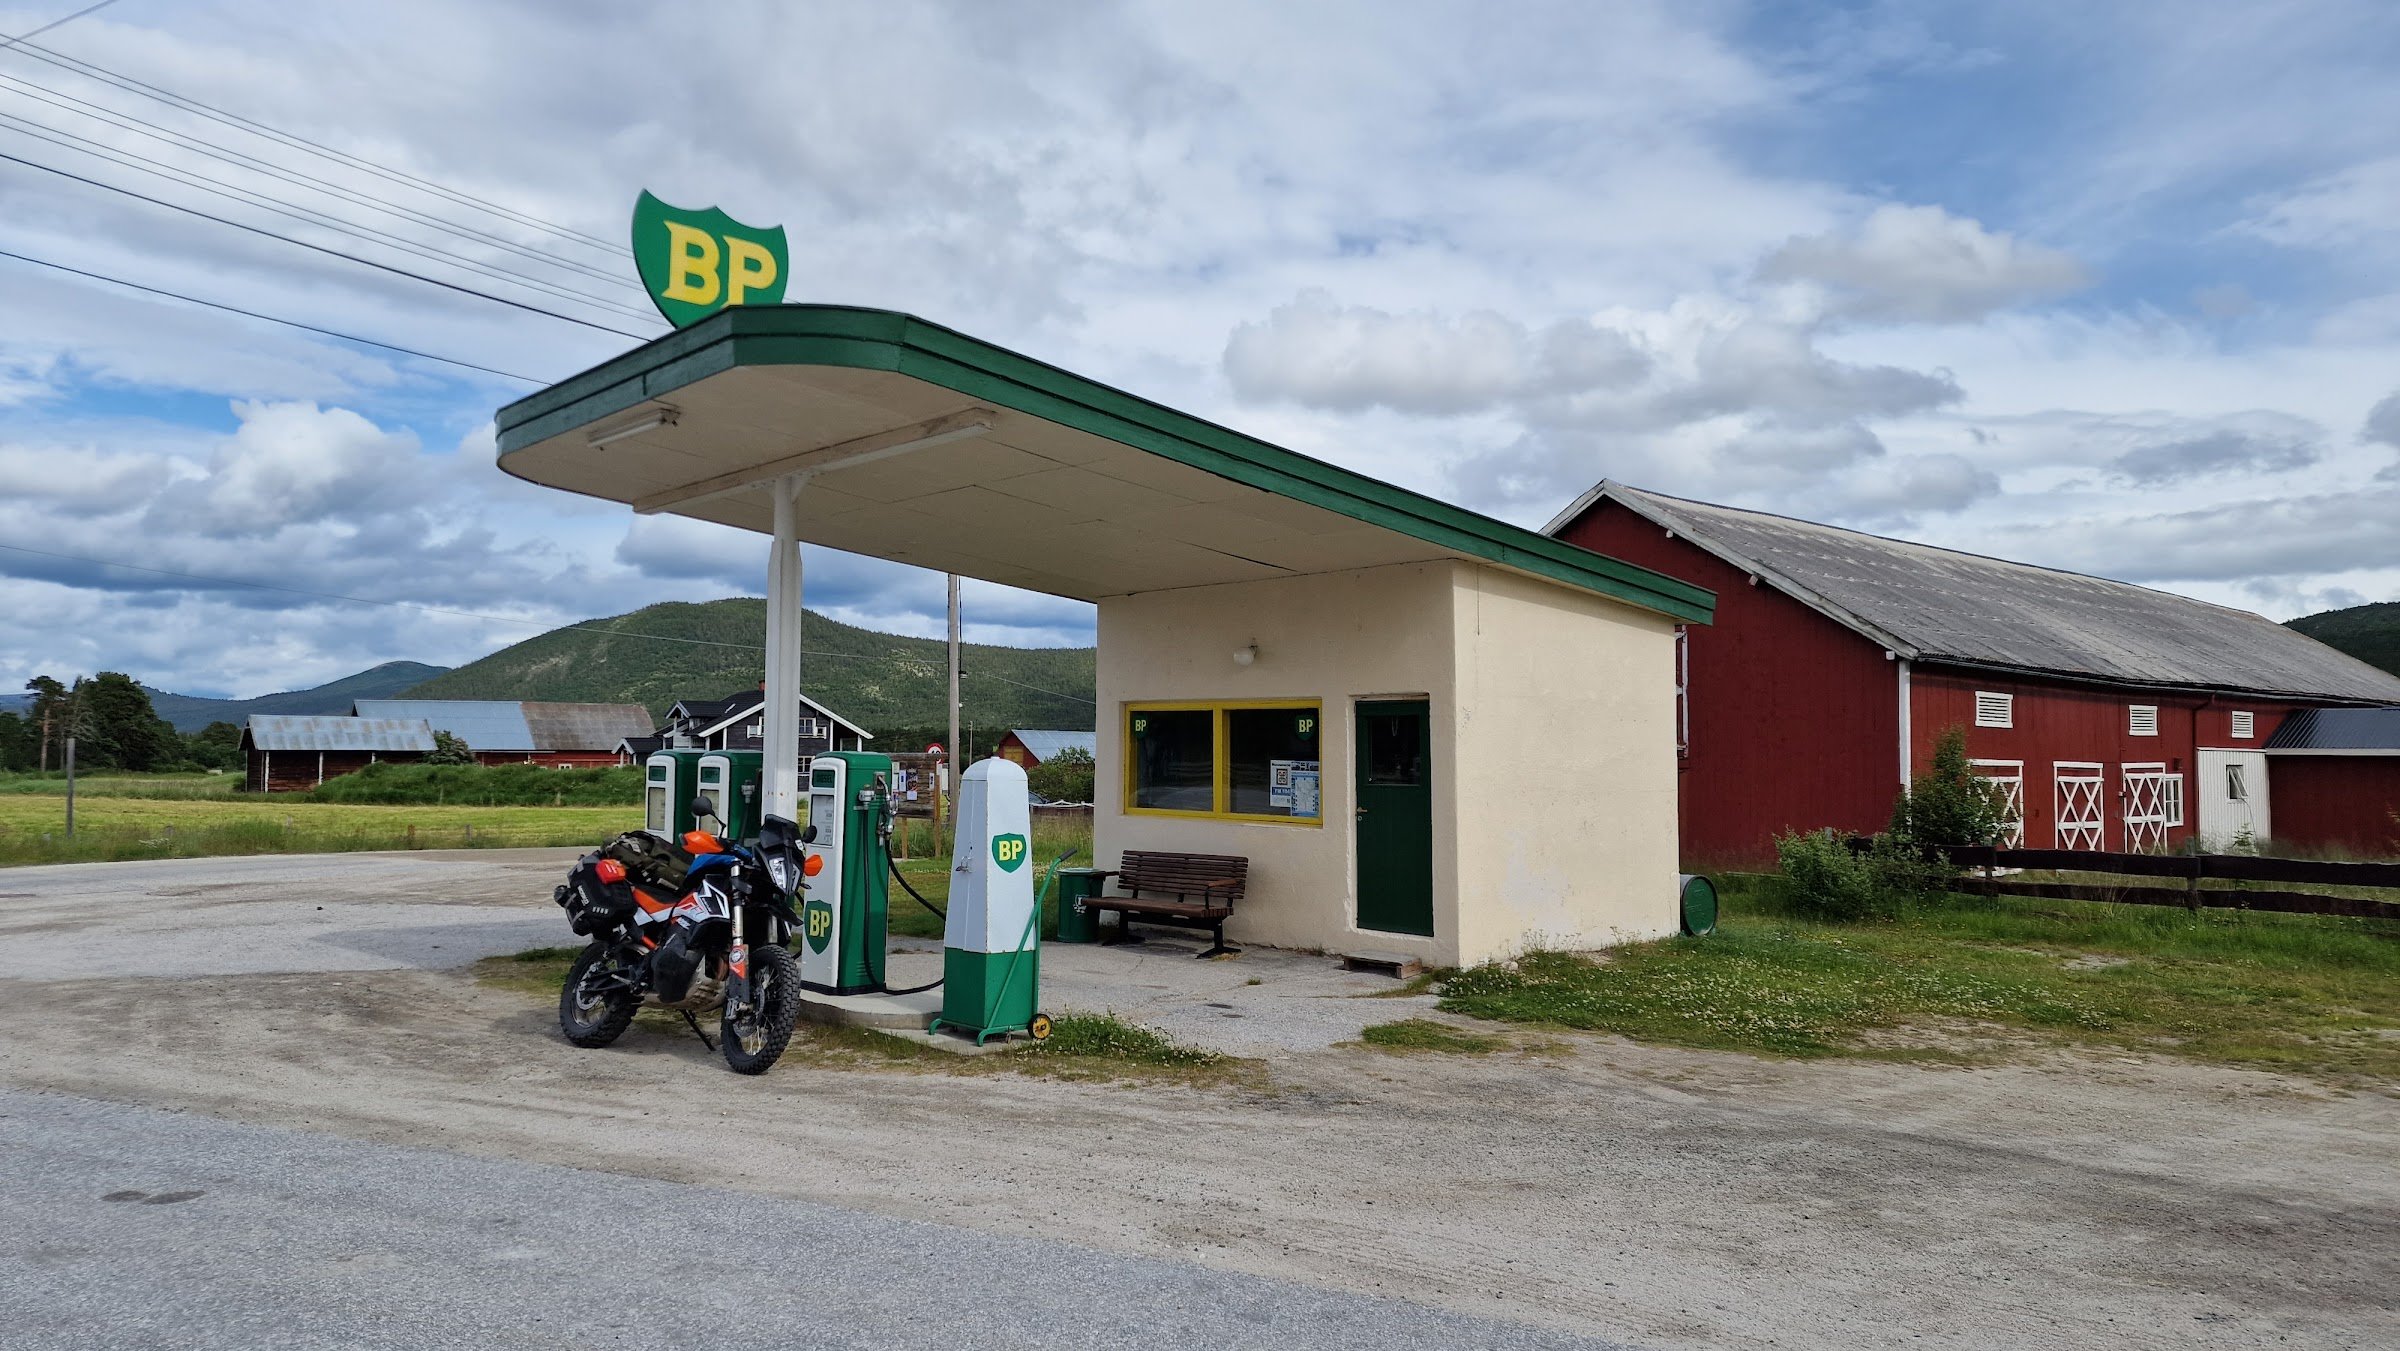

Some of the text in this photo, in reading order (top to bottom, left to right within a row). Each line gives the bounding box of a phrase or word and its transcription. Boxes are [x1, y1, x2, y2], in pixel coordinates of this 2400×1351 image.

[661, 220, 777, 308] BP
[1135, 719, 1147, 732] BP
[1298, 719, 1314, 733] BP
[998, 840, 1023, 861] BP
[809, 909, 830, 938] BP
